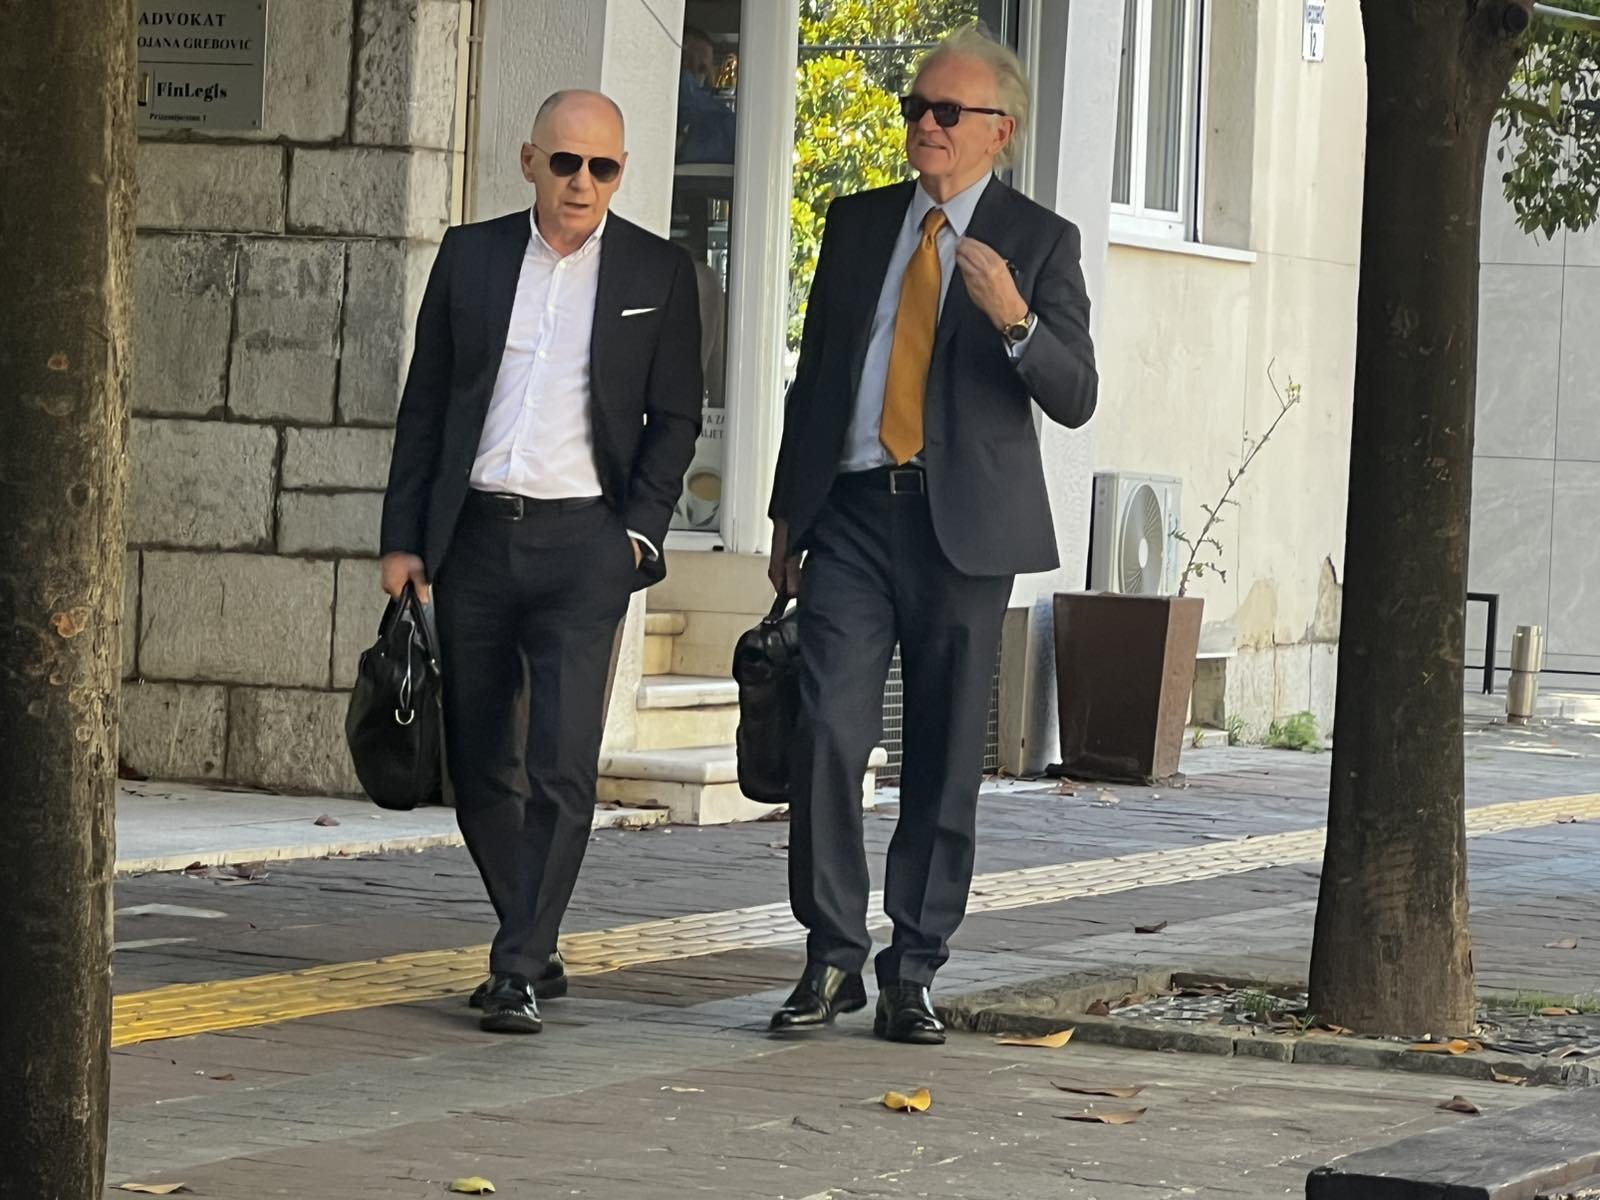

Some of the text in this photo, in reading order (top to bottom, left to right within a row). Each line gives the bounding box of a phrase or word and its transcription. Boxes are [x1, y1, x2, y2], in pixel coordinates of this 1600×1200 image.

[137, 12, 226, 26] ADVOKAT
[137, 36, 180, 49] OJANA
[157, 82, 227, 102] FinLegis
